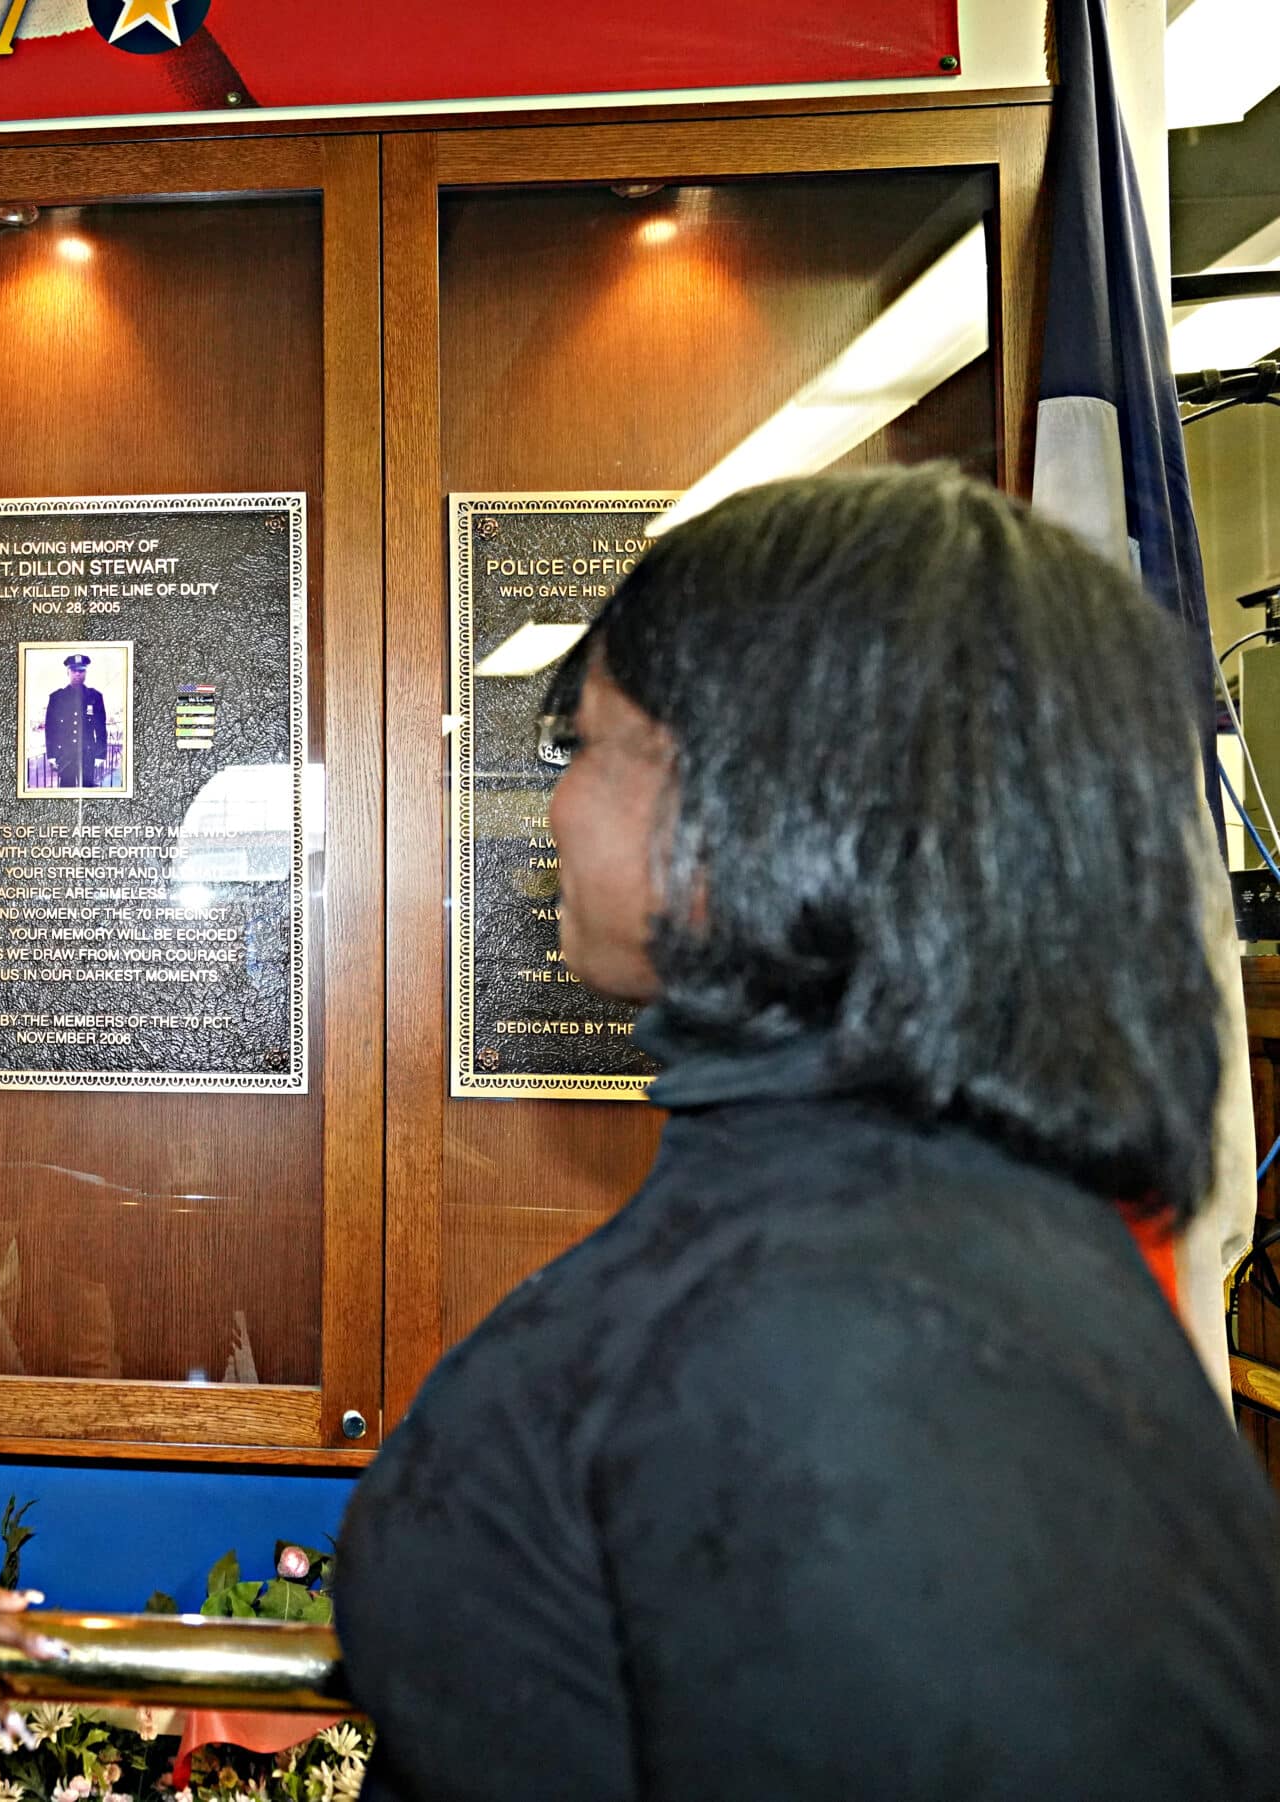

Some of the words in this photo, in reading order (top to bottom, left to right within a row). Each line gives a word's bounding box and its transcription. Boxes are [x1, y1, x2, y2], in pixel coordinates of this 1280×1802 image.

[14, 542, 66, 555] LOVING
[71, 541, 134, 554] MEMORY
[139, 540, 159, 553] OF
[593, 540, 609, 552] IN
[20, 560, 84, 576] DILLON
[90, 558, 179, 574] STEWART
[486, 559, 565, 575] POLICE
[23, 586, 70, 598] KILLED
[74, 585, 88, 597] IN
[90, 585, 119, 597] THE
[122, 584, 153, 596] LINE
[157, 583, 177, 595] OF
[181, 583, 219, 595] DUTY
[500, 586, 533, 597] WHO
[539, 586, 577, 597] GAVE
[582, 586, 607, 597] HIS
[33, 602, 62, 614] NOV.
[66, 602, 85, 614] 28,
[89, 601, 120, 613] 2005
[16, 826, 35, 838] OF
[39, 826, 68, 838] LIFE
[72, 826, 101, 838] ARE
[105, 826, 141, 838] KEPT
[145, 826, 164, 838] BY
[168, 826, 198, 838] MEN
[31, 847, 105, 860] COURAGE,
[109, 847, 189, 858] FORTITUDE
[6, 867, 44, 878] YOUR
[48, 867, 124, 878] STRENGTH
[127, 867, 158, 878] AND
[65, 887, 94, 899] ARE
[22, 908, 77, 920] WOMEN
[81, 908, 100, 920] OF
[104, 908, 132, 920] THE
[136, 908, 151, 920] 70
[155, 908, 227, 920] PRECINCT
[9, 928, 48, 940] YOUR
[52, 928, 113, 940] MEMORY
[117, 929, 150, 941] WILL
[154, 929, 172, 941] BE
[176, 929, 237, 941] ECHOED
[7, 949, 30, 960] WE
[33, 949, 74, 960] DRAW
[79, 949, 119, 960] FROM
[122, 950, 162, 961] YOUR
[166, 950, 238, 961] COURAGE
[0, 969, 19, 981] US
[23, 969, 37, 981] IN
[41, 969, 71, 981] OUR
[76, 970, 142, 982] DARKEST
[0, 1014, 18, 1027] BY
[22, 1015, 50, 1028] THE
[54, 1015, 124, 1028] MEMBERS
[128, 1015, 149, 1028] OF
[151, 1016, 179, 1029] THE
[184, 1016, 199, 1029] 70
[496, 1023, 579, 1034] DEDICATED
[585, 1023, 603, 1034] BY
[608, 1023, 636, 1034] THE
[17, 1032, 96, 1045] NOVEMBER
[100, 1032, 132, 1045] 2006
